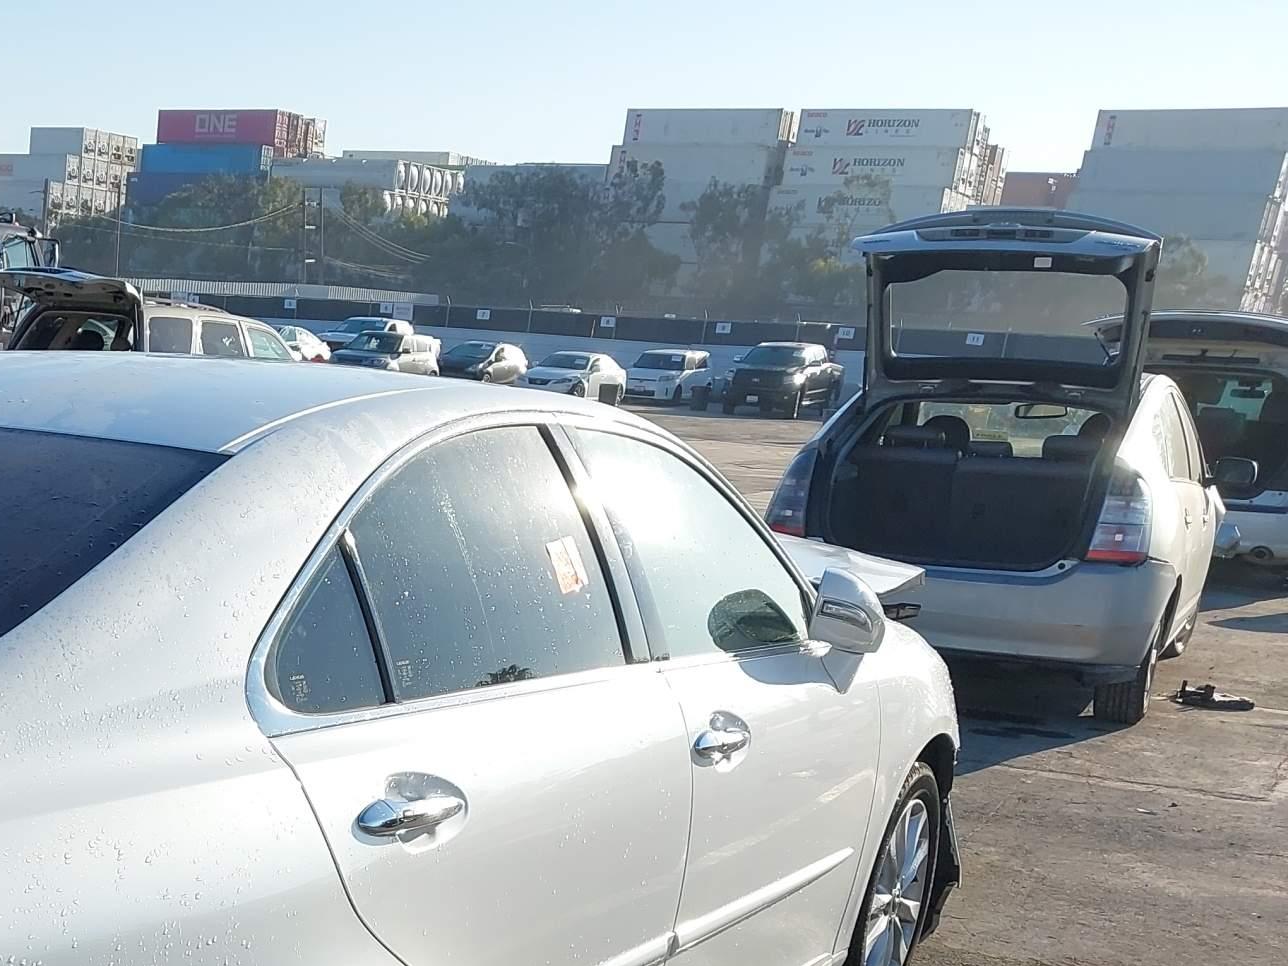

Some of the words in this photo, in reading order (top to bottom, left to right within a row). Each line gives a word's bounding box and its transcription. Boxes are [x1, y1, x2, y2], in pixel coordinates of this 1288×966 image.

[195, 114, 237, 133] ONE
[867, 119, 920, 128] HORIZON
[853, 158, 905, 167] HORIZON
